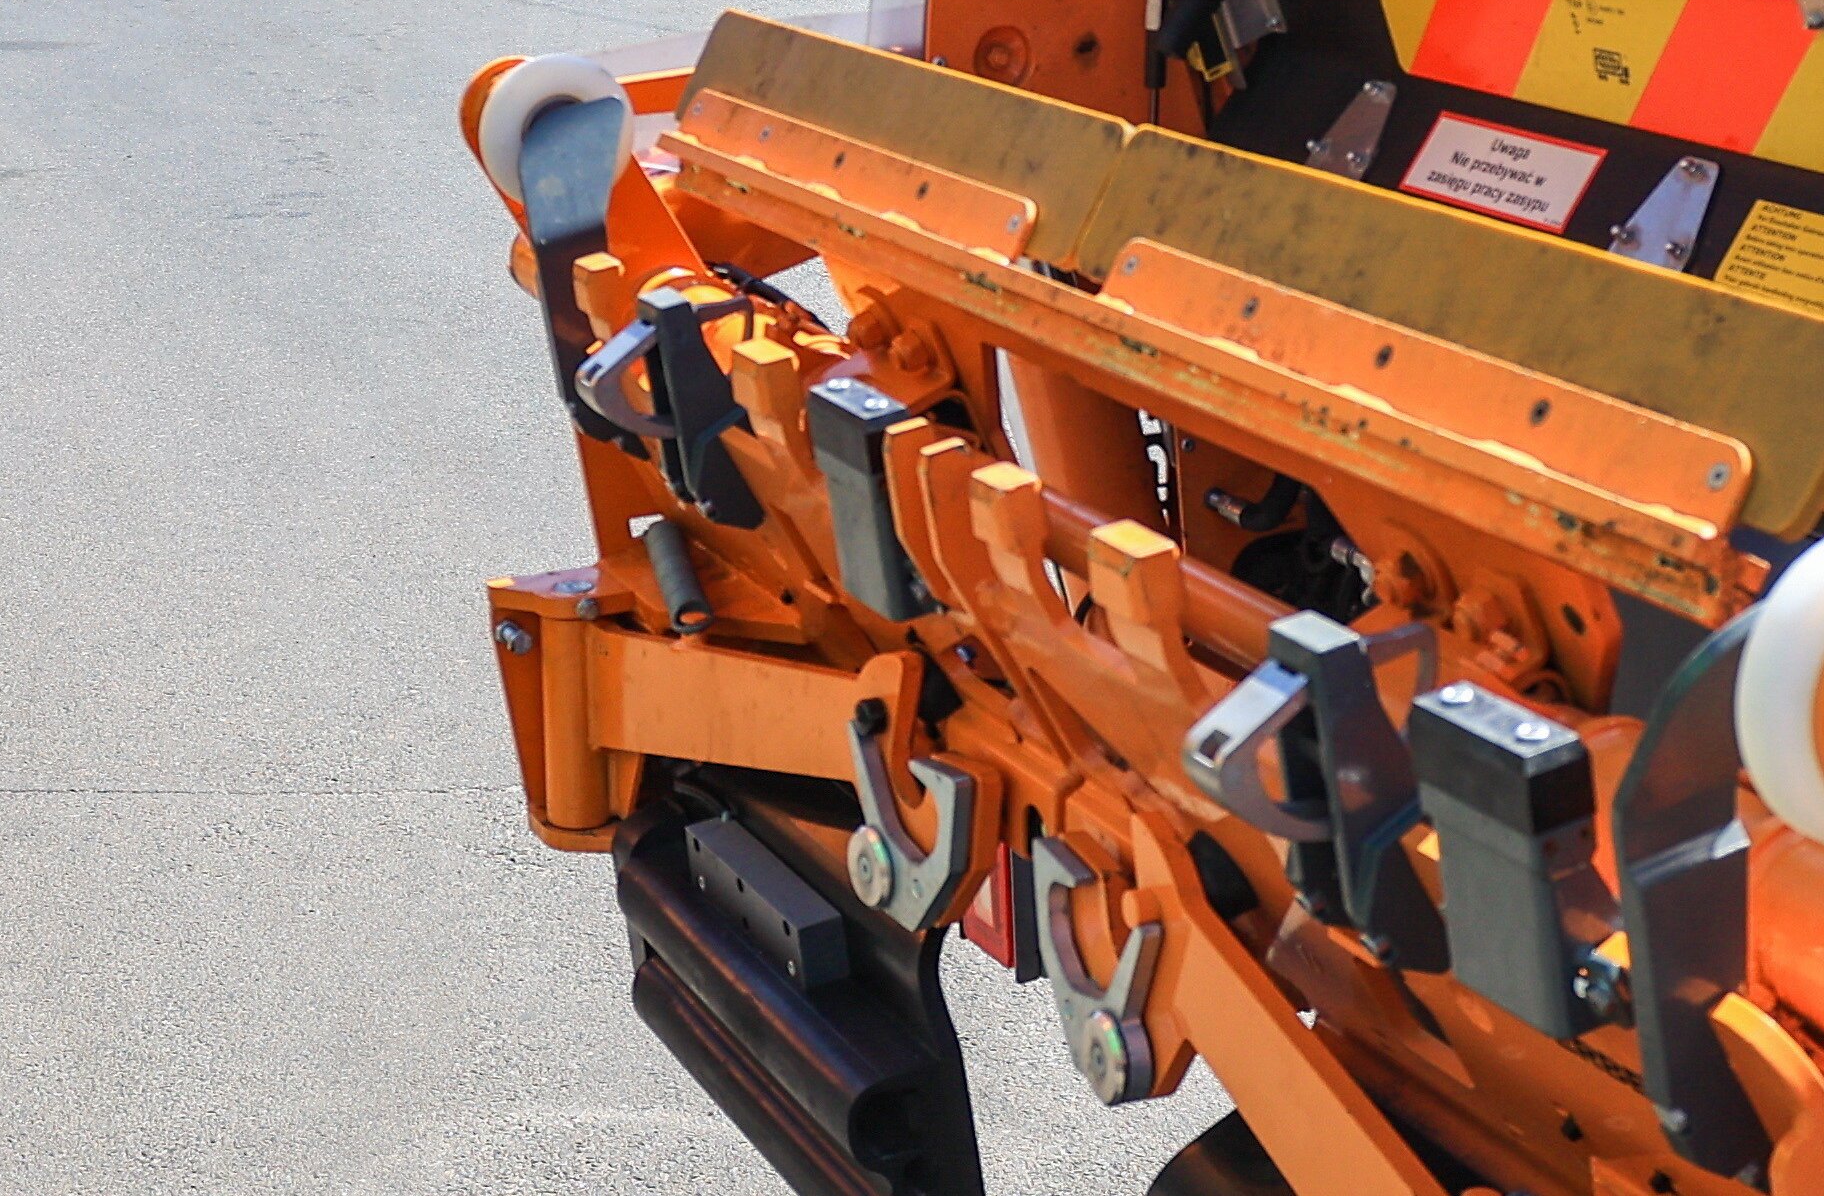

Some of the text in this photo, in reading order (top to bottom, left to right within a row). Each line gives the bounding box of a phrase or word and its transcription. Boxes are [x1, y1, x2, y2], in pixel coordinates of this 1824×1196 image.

[1490, 138, 1531, 162] Uwaga
[1451, 151, 1547, 187] Nie przebywać w
[1427, 169, 1550, 213] zasięgu pracy zasypu
